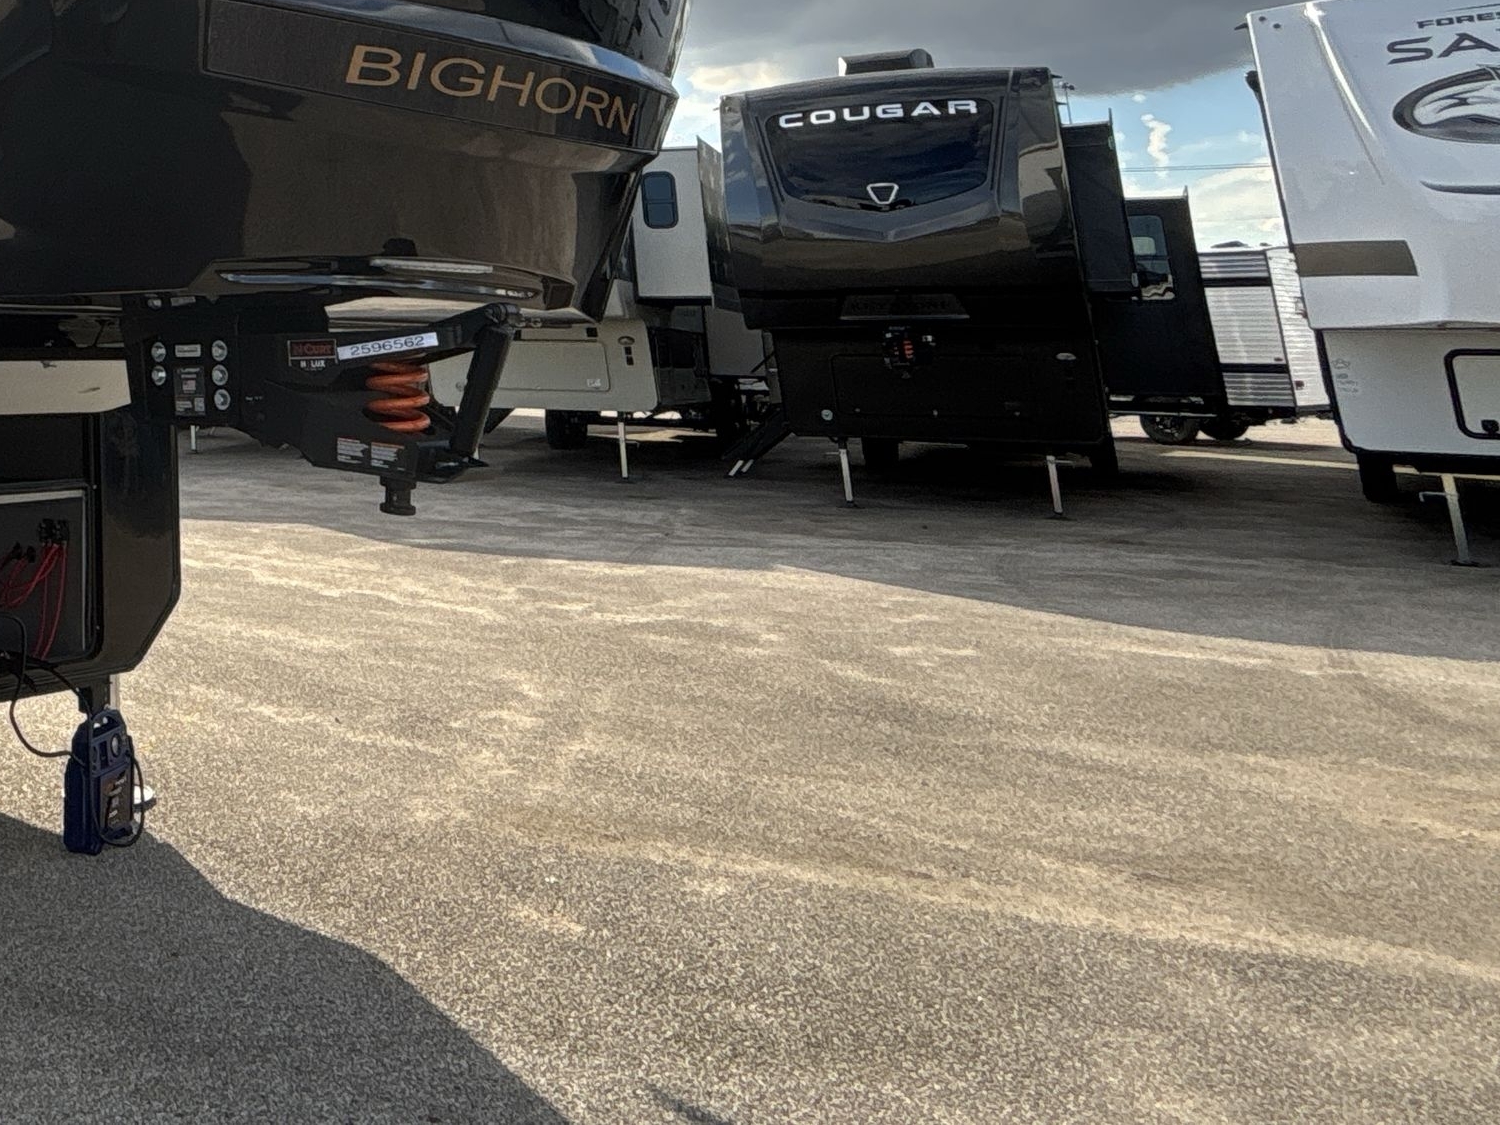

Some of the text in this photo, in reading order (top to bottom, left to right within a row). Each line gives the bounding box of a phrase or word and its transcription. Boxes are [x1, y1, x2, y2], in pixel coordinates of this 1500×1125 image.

[1386, 27, 1500, 65] SA
[345, 44, 638, 136] BIGHORN
[778, 99, 978, 129] COUGAR
[350, 335, 425, 356] 2596562
